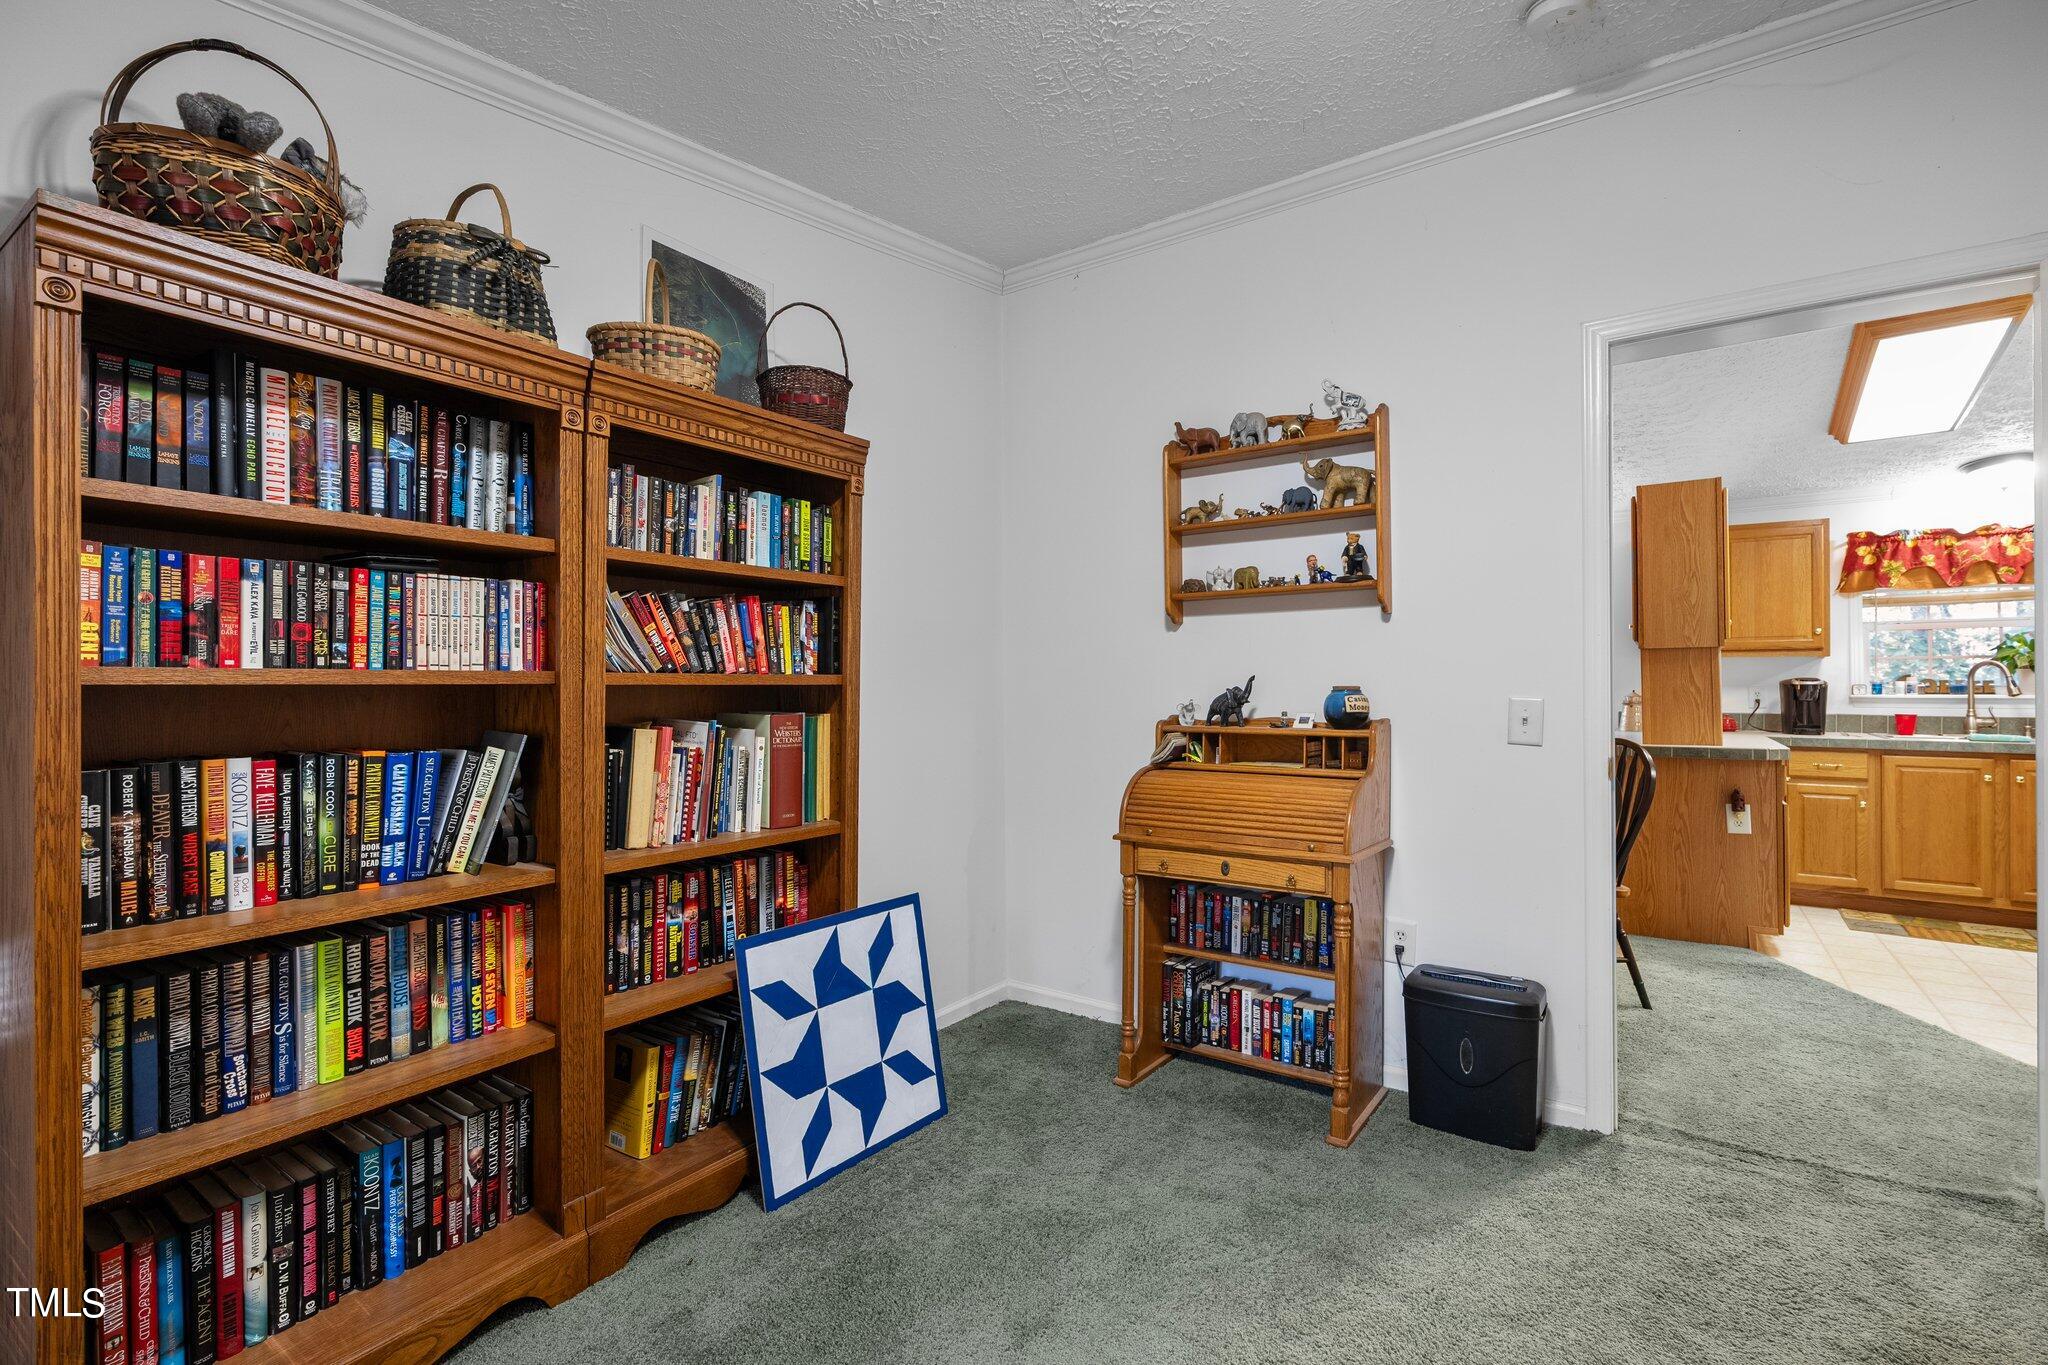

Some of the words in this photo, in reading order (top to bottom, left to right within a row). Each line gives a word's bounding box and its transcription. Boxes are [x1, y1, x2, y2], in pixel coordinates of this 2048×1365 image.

[245, 361, 255, 395] MICHAEL
[97, 383, 112, 424] FORCE
[110, 385, 121, 426] TRIBULATION
[266, 374, 286, 430] MICHAEL
[323, 384, 337, 420] PATRICIA
[347, 387, 359, 408] JAMES
[372, 393, 384, 419] JONATHAN
[193, 400, 205, 442] NICOLAE
[246, 398, 255, 438] CONNELLY
[348, 408, 360, 442] PATTERSON
[397, 405, 405, 435] CUSSLER
[246, 439, 255, 460] ECHO
[323, 422, 338, 463] CORNWELL
[373, 420, 384, 450] KELLERMAN
[246, 461, 256, 482] PARK
[266, 438, 286, 503] CRICHTON
[349, 451, 359, 483] POSTCARD
[320, 468, 341, 505] TRACE
[350, 483, 359, 507] KILLERS
[372, 468, 384, 508] OBSESSION
[625, 476, 633, 501] JEFFREY
[625, 503, 633, 527] ARCHER
[81, 567, 90, 601] KELLERMAN
[90, 570, 99, 600] JONATHAN
[160, 566, 171, 601] KELLERMAN
[172, 568, 181, 600] JONATHAN
[192, 583, 204, 611] JACKSON
[204, 591, 213, 604] LISA
[250, 582, 258, 600] ALEX
[295, 574, 307, 592] JULIE
[372, 585, 383, 606] JANET
[250, 602, 258, 619] KAVA
[297, 592, 307, 622] GARWOOD
[335, 591, 345, 613] MICHAEL
[81, 621, 99, 661] GONE
[336, 614, 345, 639] CONNELLY
[371, 607, 383, 642] EVANOVICH
[161, 621, 181, 662] RAGE
[198, 639, 206, 660] SHIVER
[250, 640, 258, 655] EVIL
[180, 766, 197, 788] JAMES
[208, 765, 223, 799] JONATHAN
[256, 768, 274, 789] FAYE
[305, 760, 315, 795] KATHY
[325, 758, 335, 787] ROBIN
[347, 760, 359, 796] STUART
[365, 763, 382, 798] PATRICIA
[392, 764, 407, 793] CLIVE
[122, 774, 133, 807] ROBERT
[231, 777, 248, 829] KOONTZ
[326, 790, 335, 817] COOK
[736, 779, 744, 812] SCHNAUZERS
[89, 805, 100, 827] CLIVE
[123, 810, 133, 819] K.
[181, 788, 197, 827] PATTERSON
[208, 800, 224, 836] KELLERMAN
[256, 793, 275, 847] KELLERMAN
[305, 800, 315, 837] REICHS
[346, 799, 358, 836] WOODS
[364, 800, 381, 843] CORNWELL
[390, 793, 407, 836] CUSSLER
[657, 803, 665, 818] BOOK
[123, 820, 134, 878] TANENBAUM
[182, 832, 198, 867] WORST
[323, 835, 336, 873] CURE
[381, 844, 392, 867] WIND
[393, 842, 405, 867] BLACK
[88, 856, 101, 898] VALHALLA
[183, 870, 199, 896] CASE
[209, 850, 225, 897] COMPULSION
[656, 879, 665, 893] DEAN
[735, 864, 745, 888] JAMES
[120, 880, 138, 916] MALICE
[671, 880, 679, 903] CUSSLER
[656, 894, 666, 923] KOONTZ
[736, 888, 746, 933] PATTERSON
[471, 919, 481, 942] JANET
[689, 921, 698, 959] CORSAIR
[701, 920, 709, 947] PRIVATE
[324, 944, 340, 980] PATRICIA
[346, 943, 362, 984] ROBIN
[369, 937, 386, 964] ROBIN
[393, 937, 407, 972] BEACH
[471, 942, 481, 979] EVANOVICH
[656, 928, 664, 972] RELENTLESS
[201, 969, 219, 1004] PATRICIA
[223, 961, 245, 1003] PATRICIA
[370, 965, 387, 991] COOK
[394, 974, 408, 1009] HOUSE
[325, 981, 340, 1024] CORNWELL
[347, 988, 363, 1026] COOK
[471, 985, 482, 1012] HOT
[201, 1005, 219, 1048] CORNWELL
[223, 1004, 247, 1058] CORNWELL
[369, 993, 387, 1044] VECTOR
[472, 1012, 482, 1032] SIX
[1174, 1010, 1182, 1037] TAILSPIN
[204, 1050, 218, 1070] Point
[346, 1027, 363, 1061] SHOCK
[205, 1072, 218, 1084] of
[223, 1071, 238, 1098] Cross
[233, 1054, 248, 1097] Southern
[201, 1085, 220, 1115] Origin
[505, 1105, 513, 1124] SUE
[670, 1105, 681, 1123] SPIRE
[672, 1091, 682, 1105] THE
[489, 1110, 497, 1130] SUE
[489, 1129, 498, 1176] GRAFTON
[505, 1123, 514, 1167] GRAFTON
[412, 1160, 425, 1186] PEARSON
[250, 1201, 261, 1223] JOHN
[327, 1178, 335, 1213] STEPHEN
[221, 1210, 234, 1242] JONATHAN
[273, 1194, 285, 1243] JUDGMENT
[284, 1204, 294, 1227] THE
[327, 1213, 335, 1234] FREY
[251, 1224, 261, 1260] GRISHAM
[102, 1256, 122, 1282] FAYE
[222, 1242, 235, 1278] KELLERMAN
[328, 1257, 336, 1287] LEGACY
[139, 1256, 151, 1300] PRESTON
[197, 1273, 210, 1301] THE
[103, 1280, 123, 1335] KELLERMAN
[138, 1298, 149, 1307] &
[139, 1307, 151, 1340] CHILD
[197, 1303, 212, 1346] AGENT
